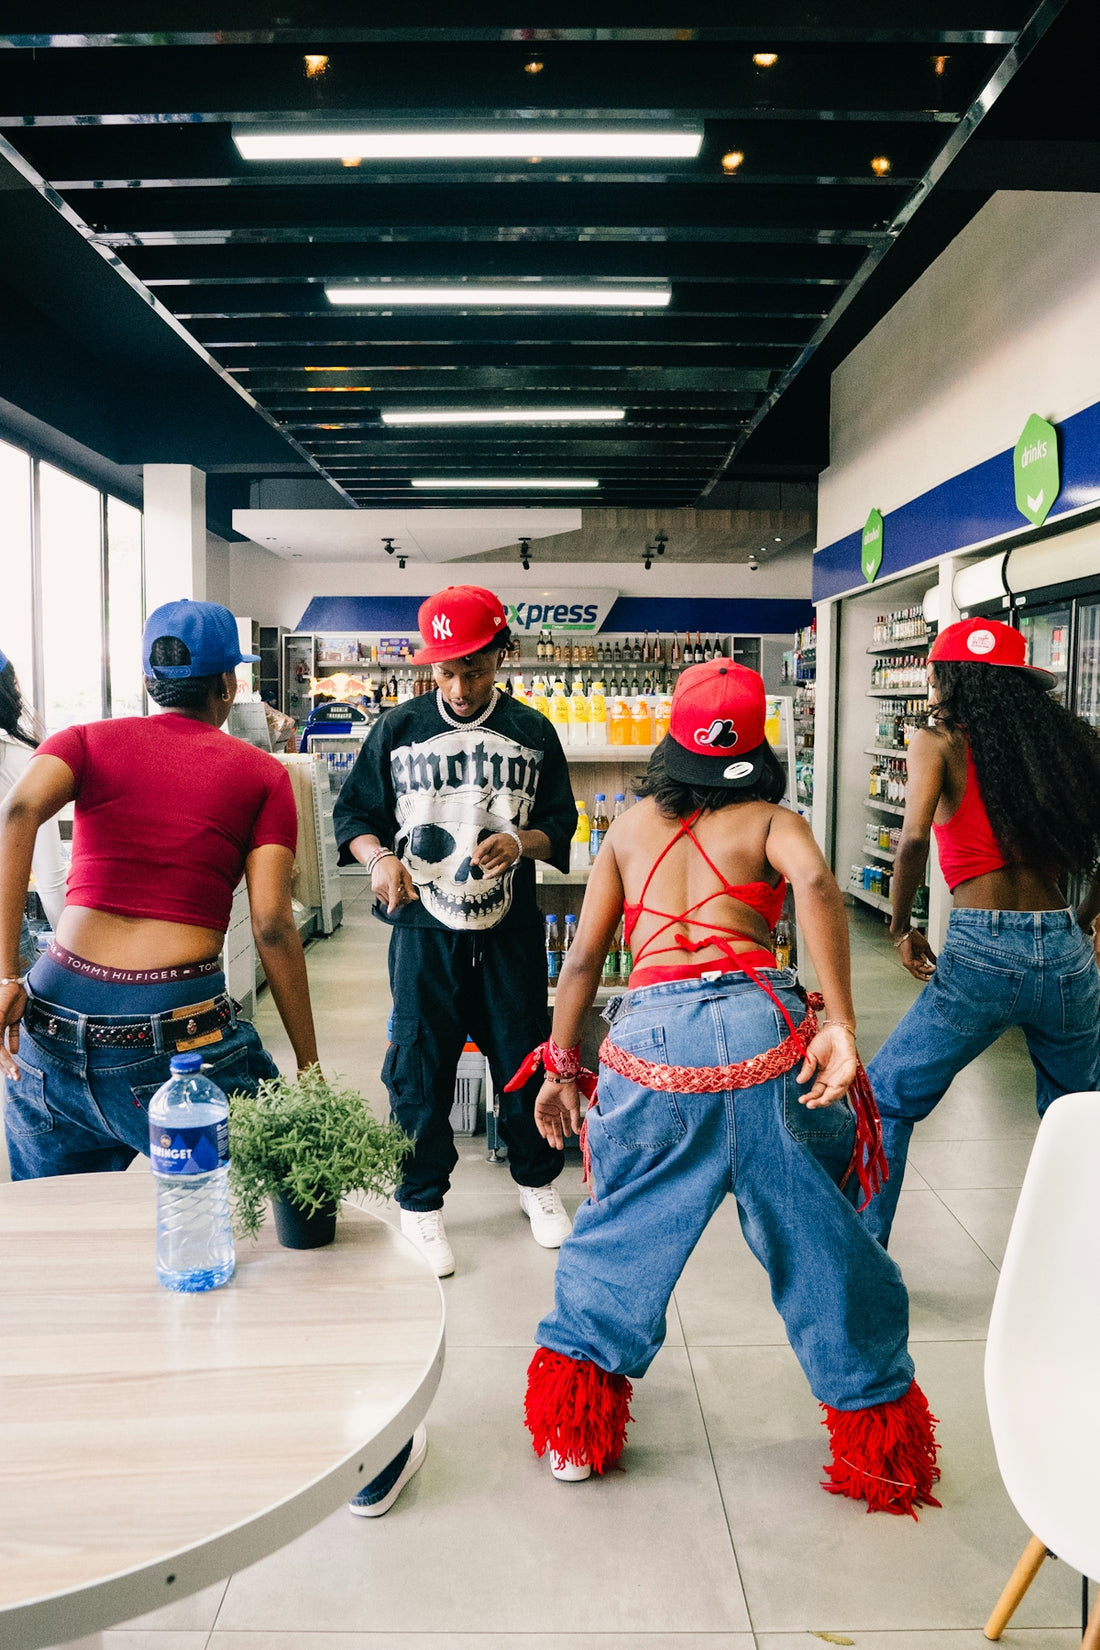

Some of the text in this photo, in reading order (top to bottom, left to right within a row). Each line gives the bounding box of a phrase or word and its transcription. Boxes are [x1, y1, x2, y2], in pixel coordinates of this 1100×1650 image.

[1021, 439, 1048, 469] drinks
[67, 956, 178, 981] TOMMY HILFIGER
